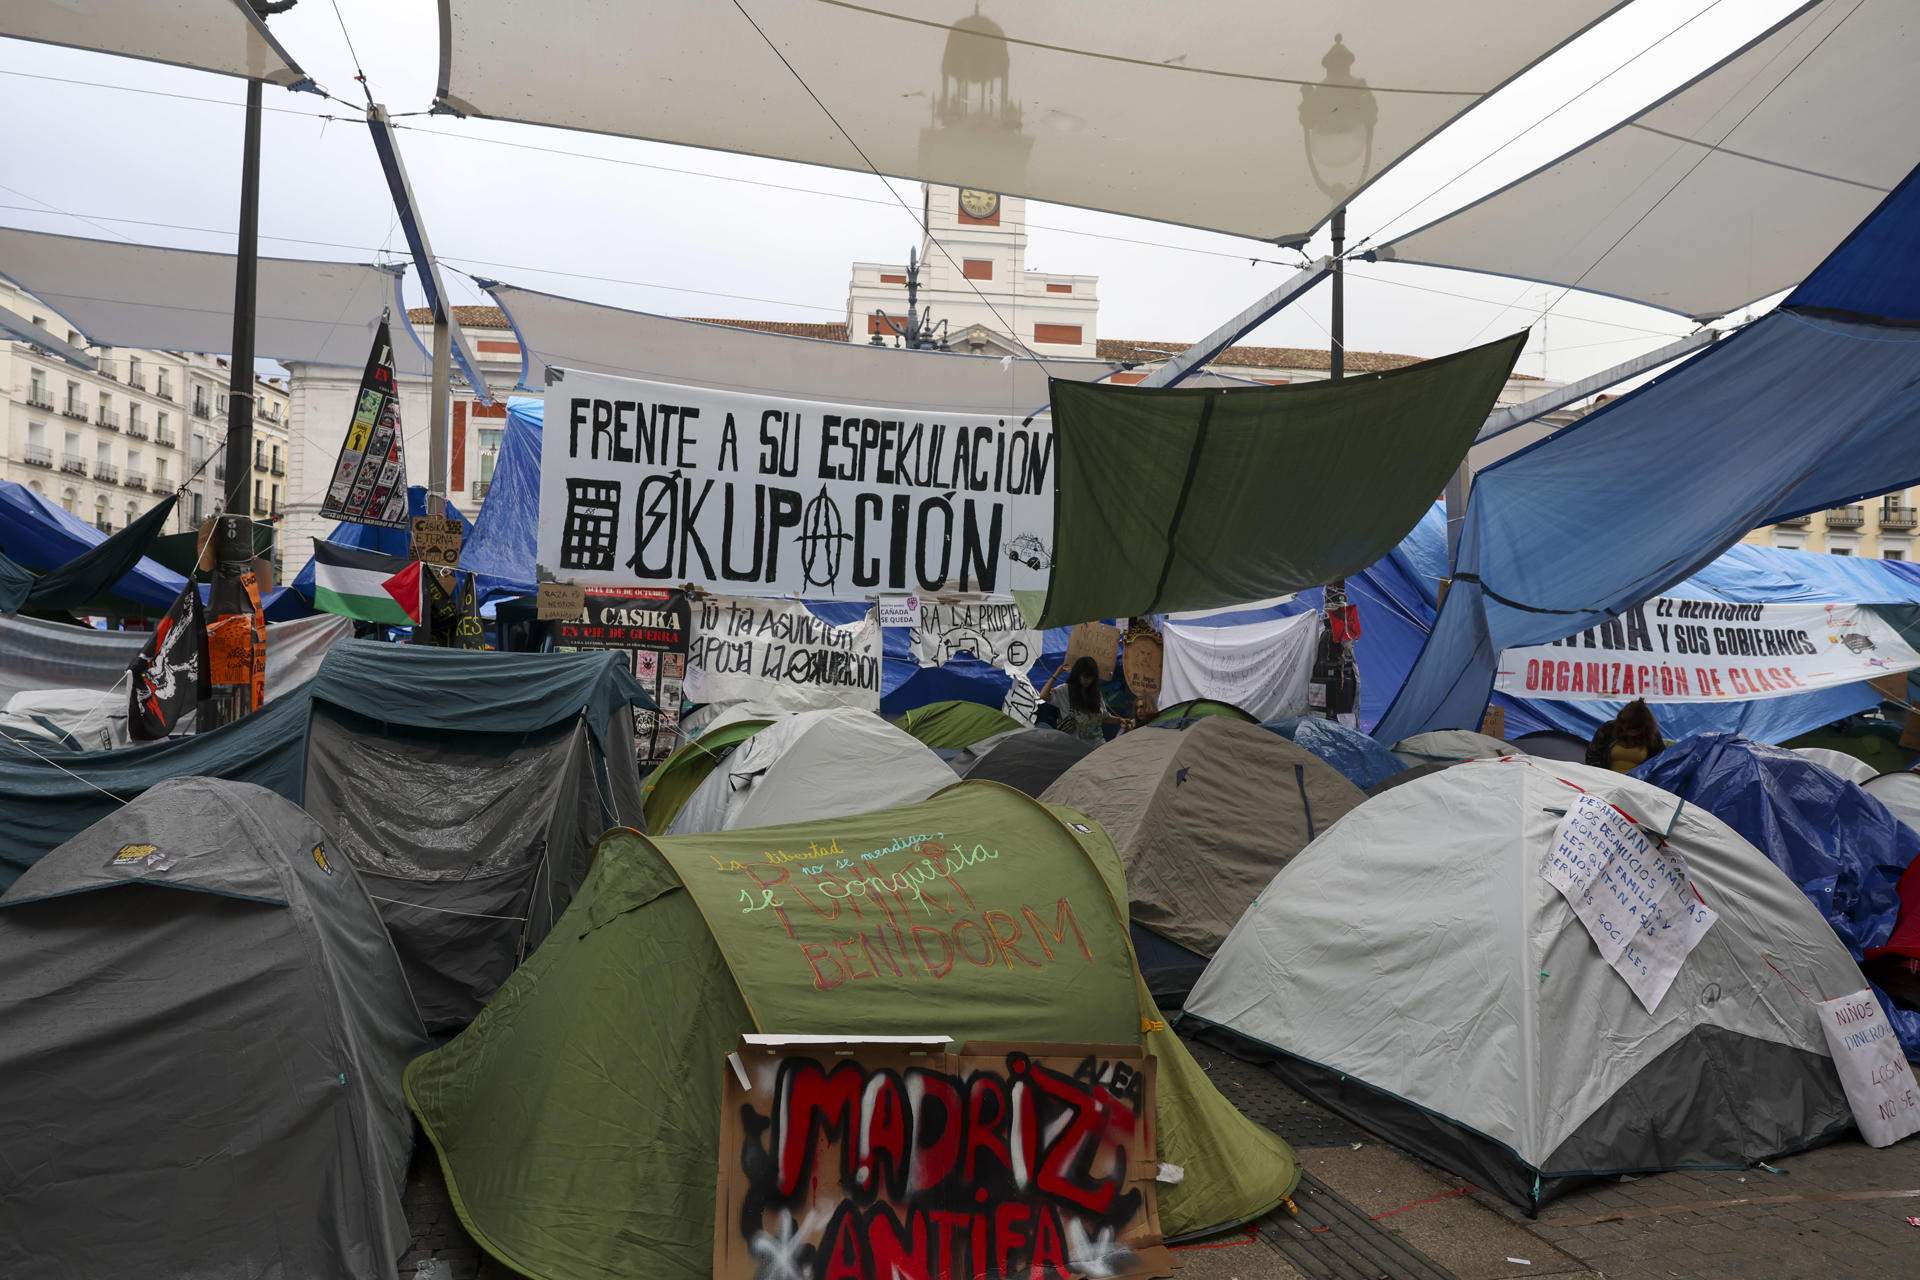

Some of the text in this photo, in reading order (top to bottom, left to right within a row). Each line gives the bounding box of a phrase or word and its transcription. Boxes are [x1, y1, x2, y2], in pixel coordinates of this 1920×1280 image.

[569, 398, 700, 469] FRENTE
[718, 412, 738, 472] A
[759, 410, 800, 478] SU
[600, 607, 680, 630] CASIKA
[952, 606, 973, 628] LA
[1657, 624, 1817, 656] Y SUS GOBIERNOS
[1526, 658, 1806, 697] ORGANIZACIÓN DE CLASE
[1559, 844, 1591, 877] HIJOS
[1578, 807, 1656, 889] LOS DESAHUCIOS
[1580, 796, 1706, 923] DESAHUCIAN FAMILIAS
[818, 841, 999, 920] conquista
[1563, 832, 1585, 851] LES
[1629, 905, 1637, 916] A
[1615, 866, 1662, 920] FAMILIAS
[801, 898, 1096, 992] BENIDORM
[1835, 1002, 1875, 1026] NIÑOS
[1879, 1099, 1897, 1121] NO
